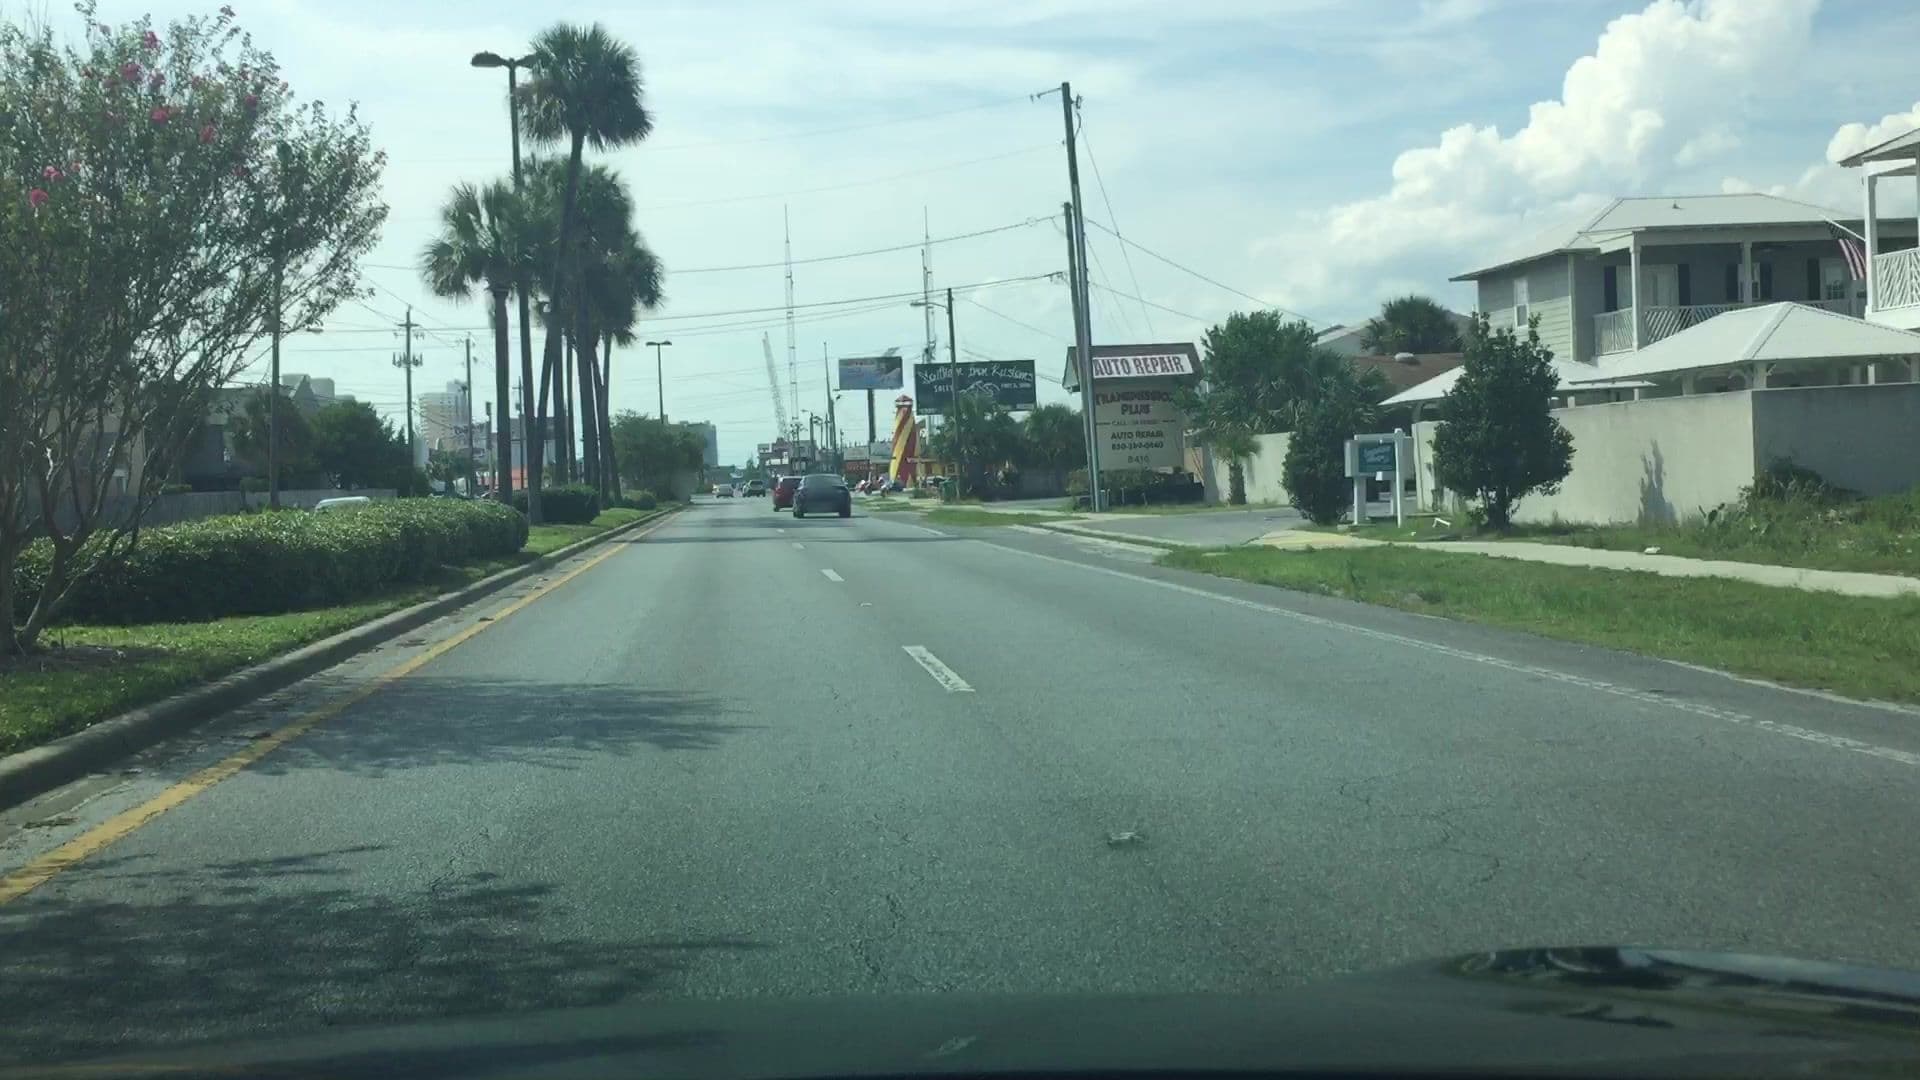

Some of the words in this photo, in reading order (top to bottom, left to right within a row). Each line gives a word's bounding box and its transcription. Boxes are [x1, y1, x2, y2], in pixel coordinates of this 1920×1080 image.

[1093, 358, 1131, 377] AUTO
[1133, 356, 1185, 376] REPAIR
[1121, 404, 1151, 415] PLUS
[1111, 432, 1134, 440] AUTO
[1136, 430, 1164, 438] REPAIR
